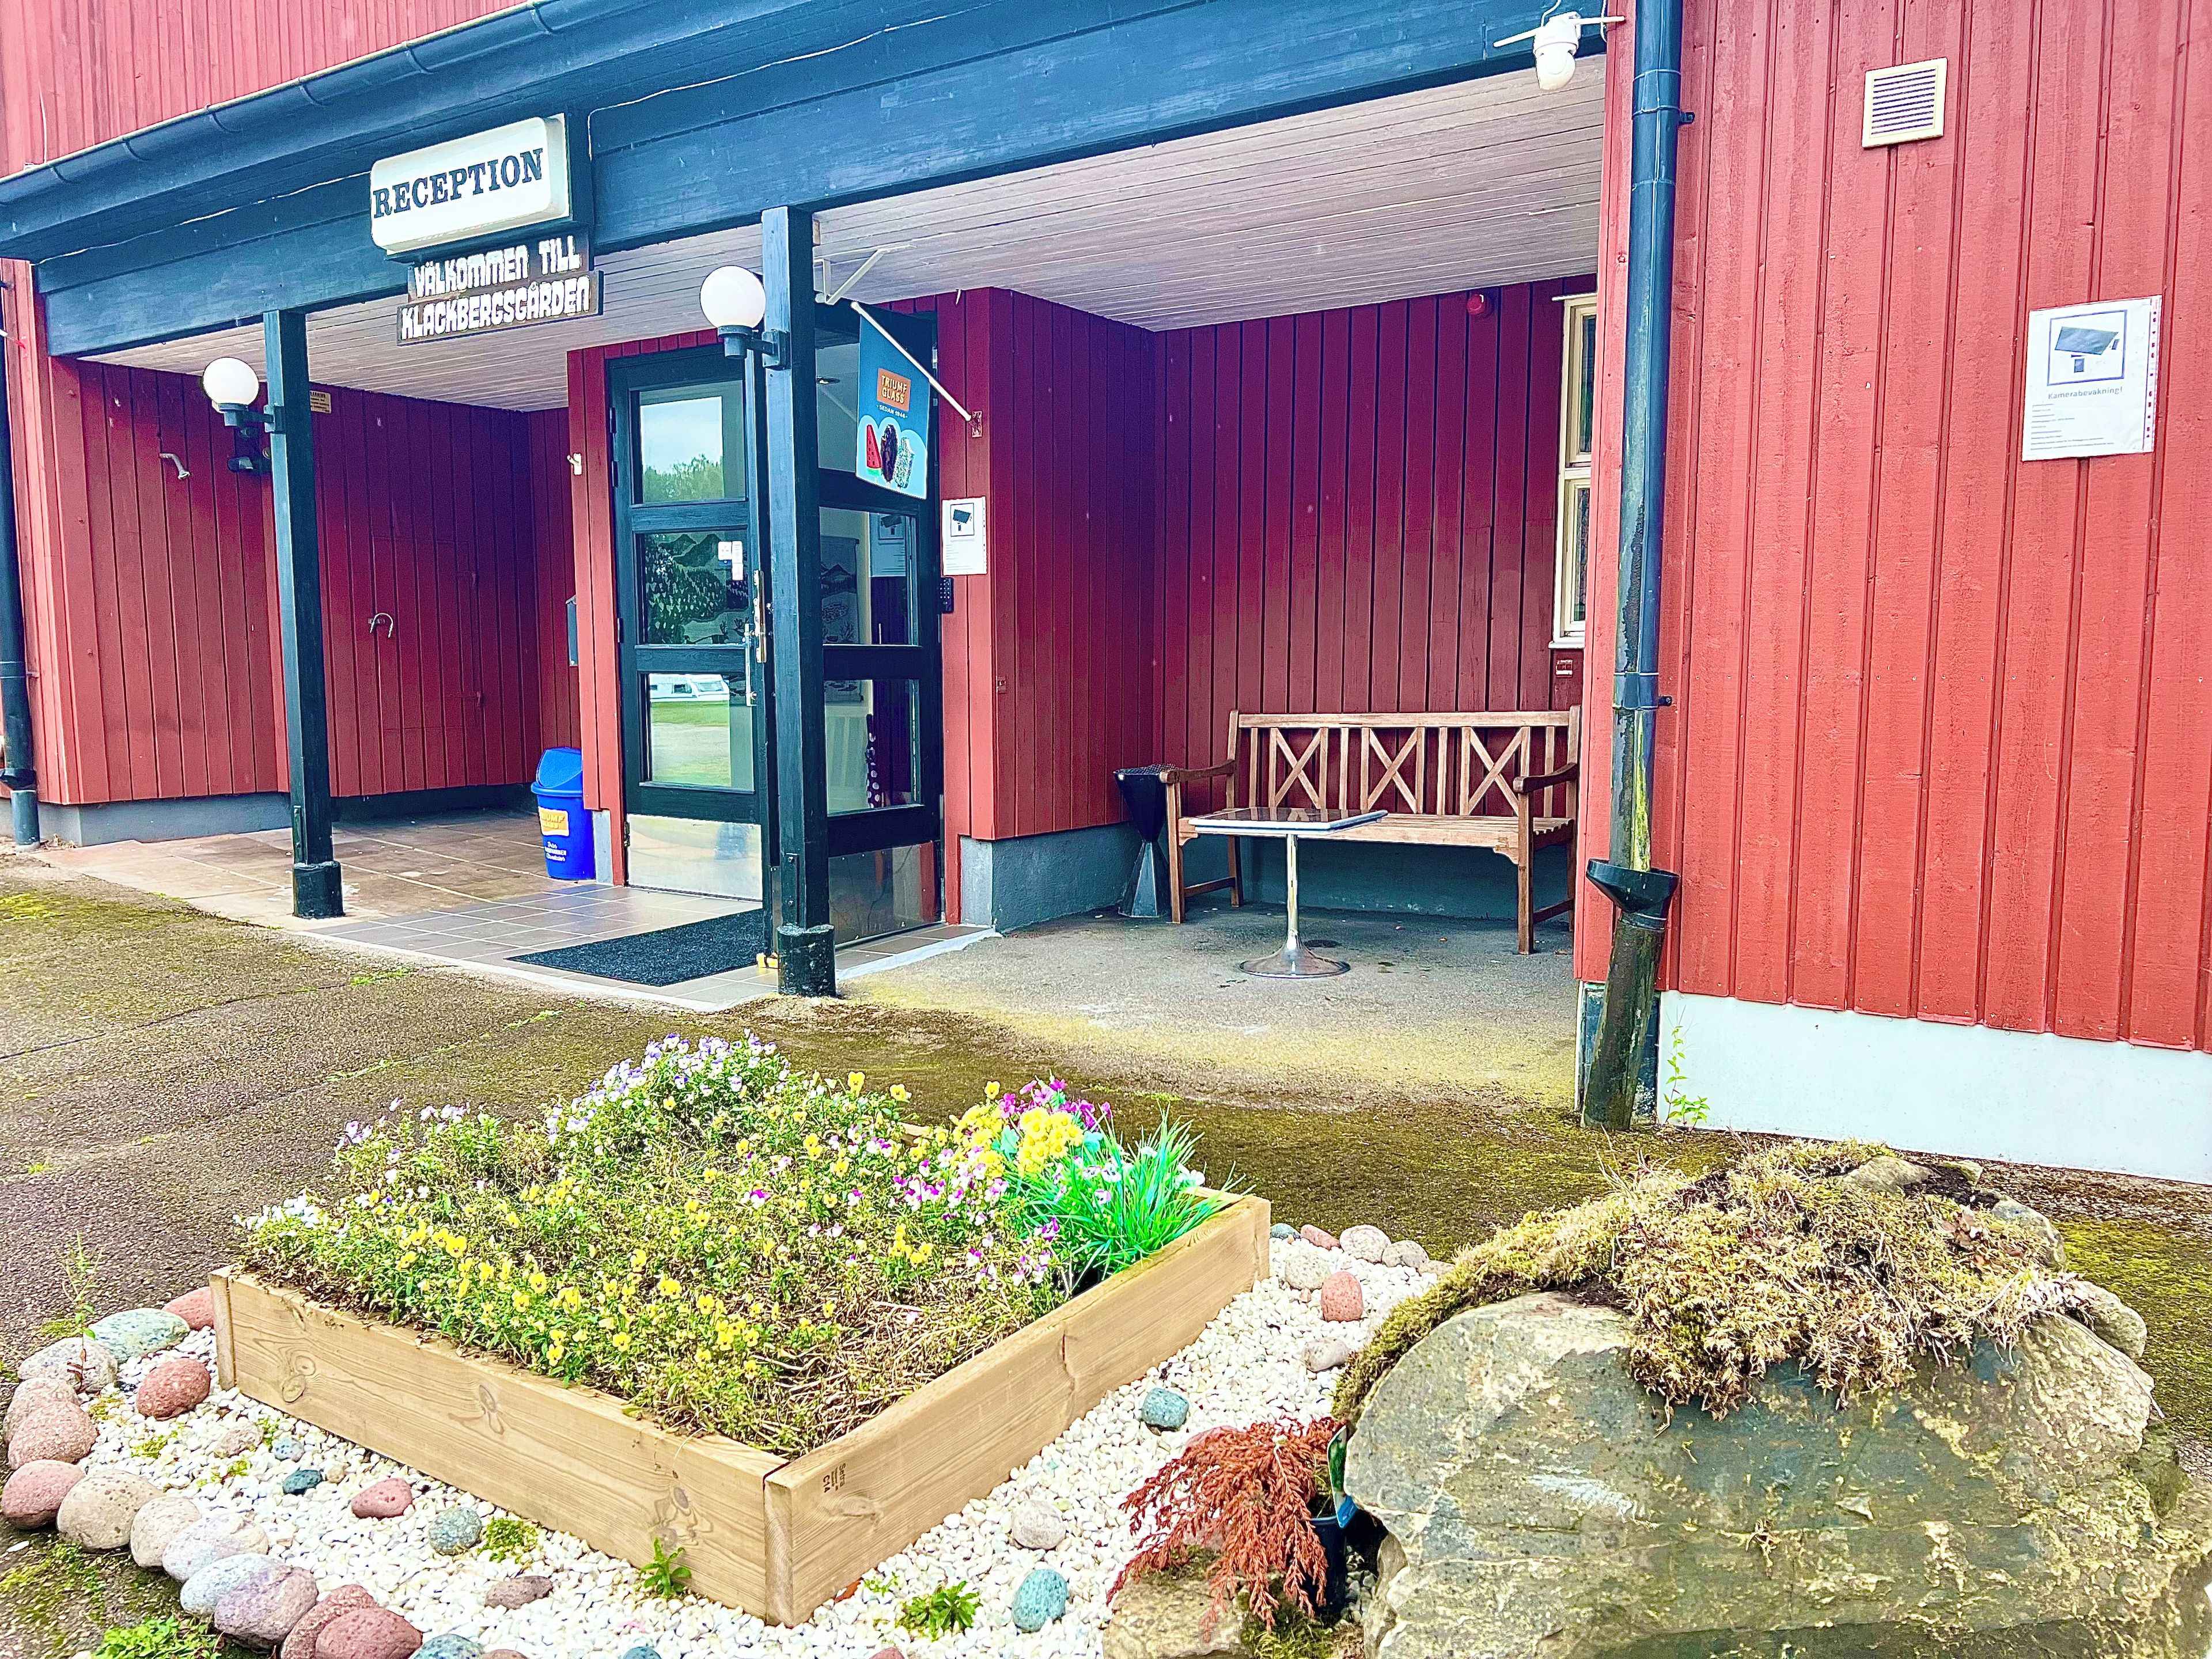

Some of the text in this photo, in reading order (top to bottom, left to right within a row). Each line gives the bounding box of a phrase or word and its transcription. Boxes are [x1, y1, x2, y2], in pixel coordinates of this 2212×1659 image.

[373, 148, 543, 218] RECEPTION
[414, 235, 582, 298] VÄLKOMMEN TILL
[401, 275, 590, 340] KLACKBERGSGÅRDEN
[881, 375, 908, 393] TRIUMF
[2048, 386, 2123, 399] Kamerabevakning!
[882, 387, 905, 404] GLASS
[879, 404, 895, 414] SEDAN
